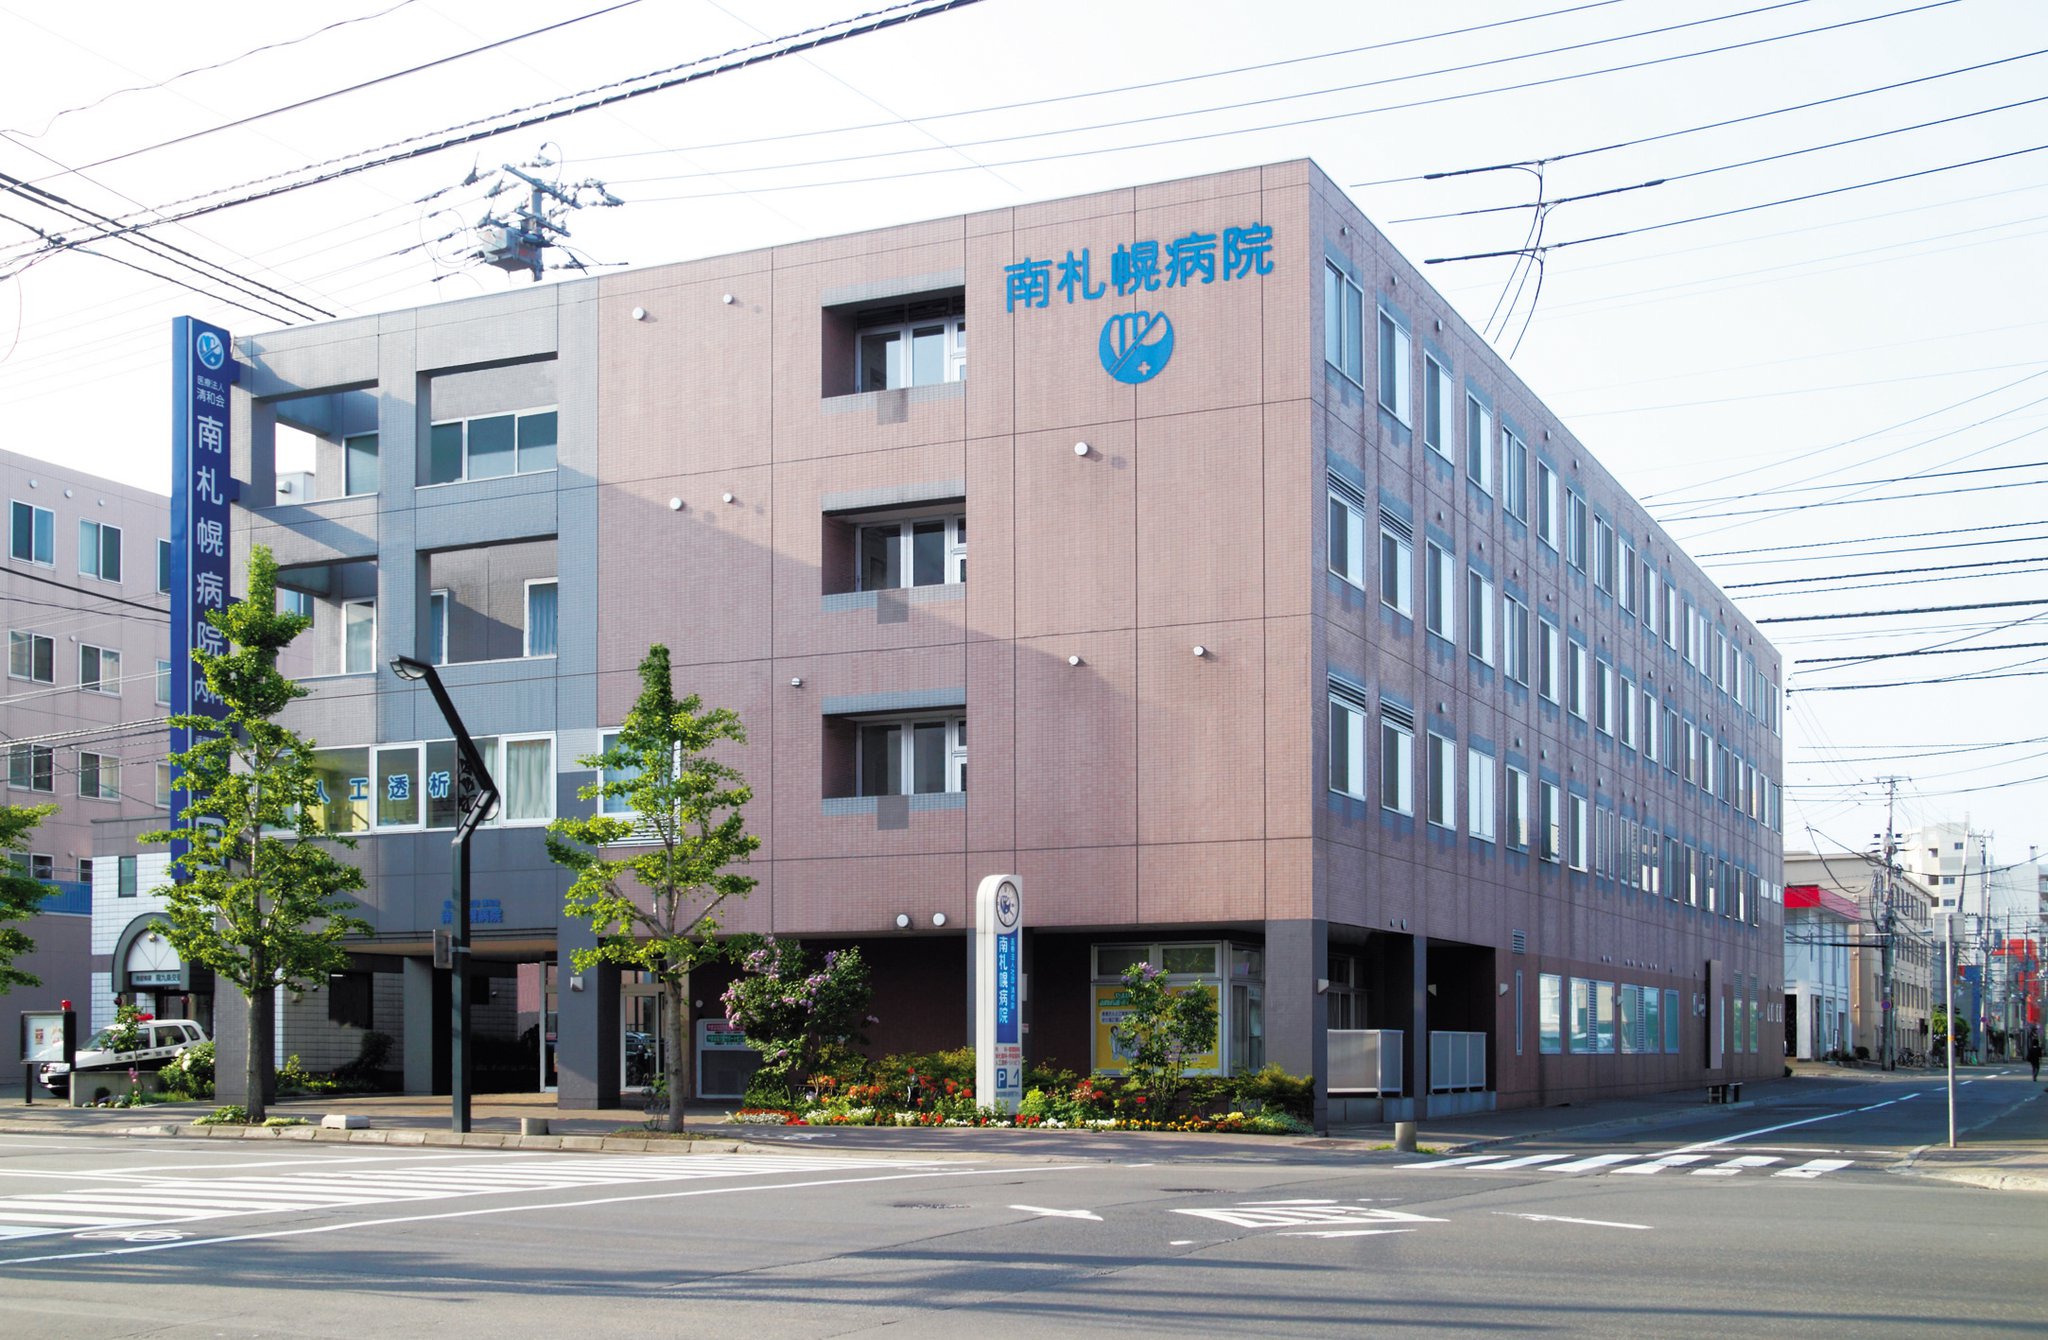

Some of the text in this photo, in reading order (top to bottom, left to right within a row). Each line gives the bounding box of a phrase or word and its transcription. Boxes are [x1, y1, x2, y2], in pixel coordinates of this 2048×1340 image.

[1004, 222, 1274, 313] 南札幌病院
[197, 387, 225, 408] 清和会
[196, 415, 224, 657] 南札幌病院
[998, 936, 1009, 1024] 南札幌病院
